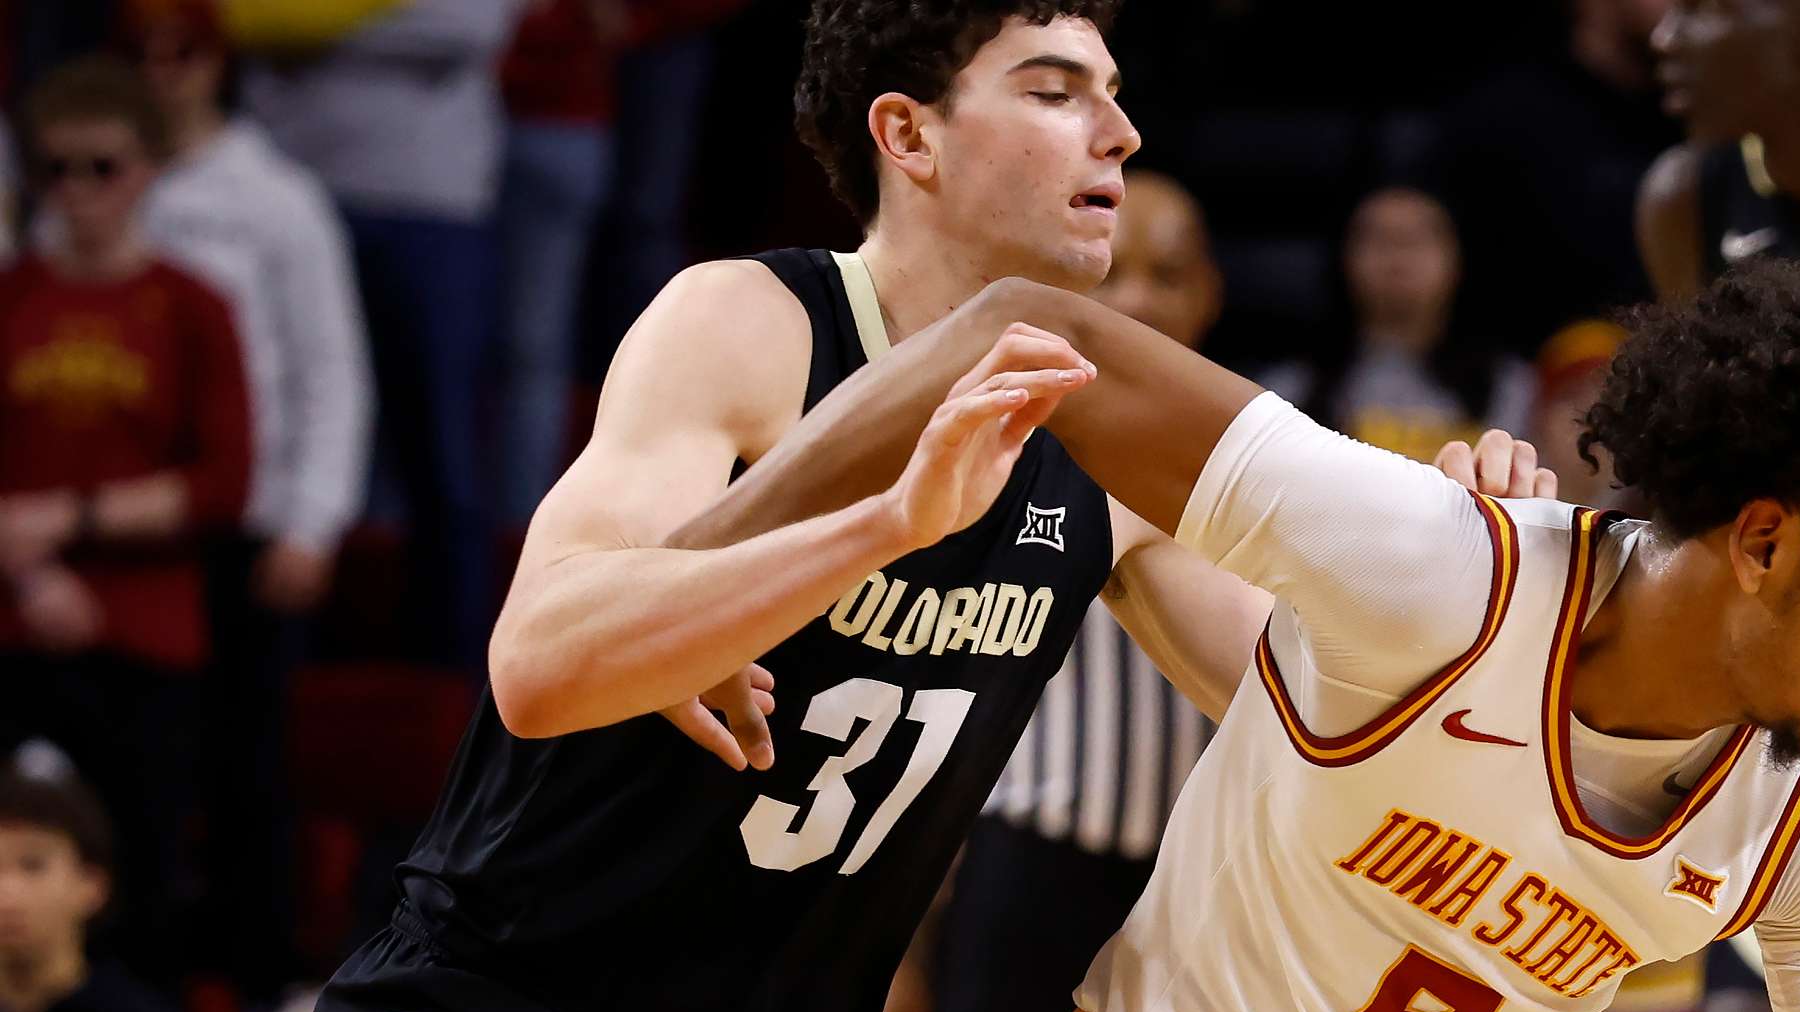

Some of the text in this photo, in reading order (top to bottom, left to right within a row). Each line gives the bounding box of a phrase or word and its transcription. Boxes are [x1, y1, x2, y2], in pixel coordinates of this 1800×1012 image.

[828, 569, 1054, 657] OLORADO
[739, 677, 976, 876] 31
[1333, 808, 1512, 928] IOWA
